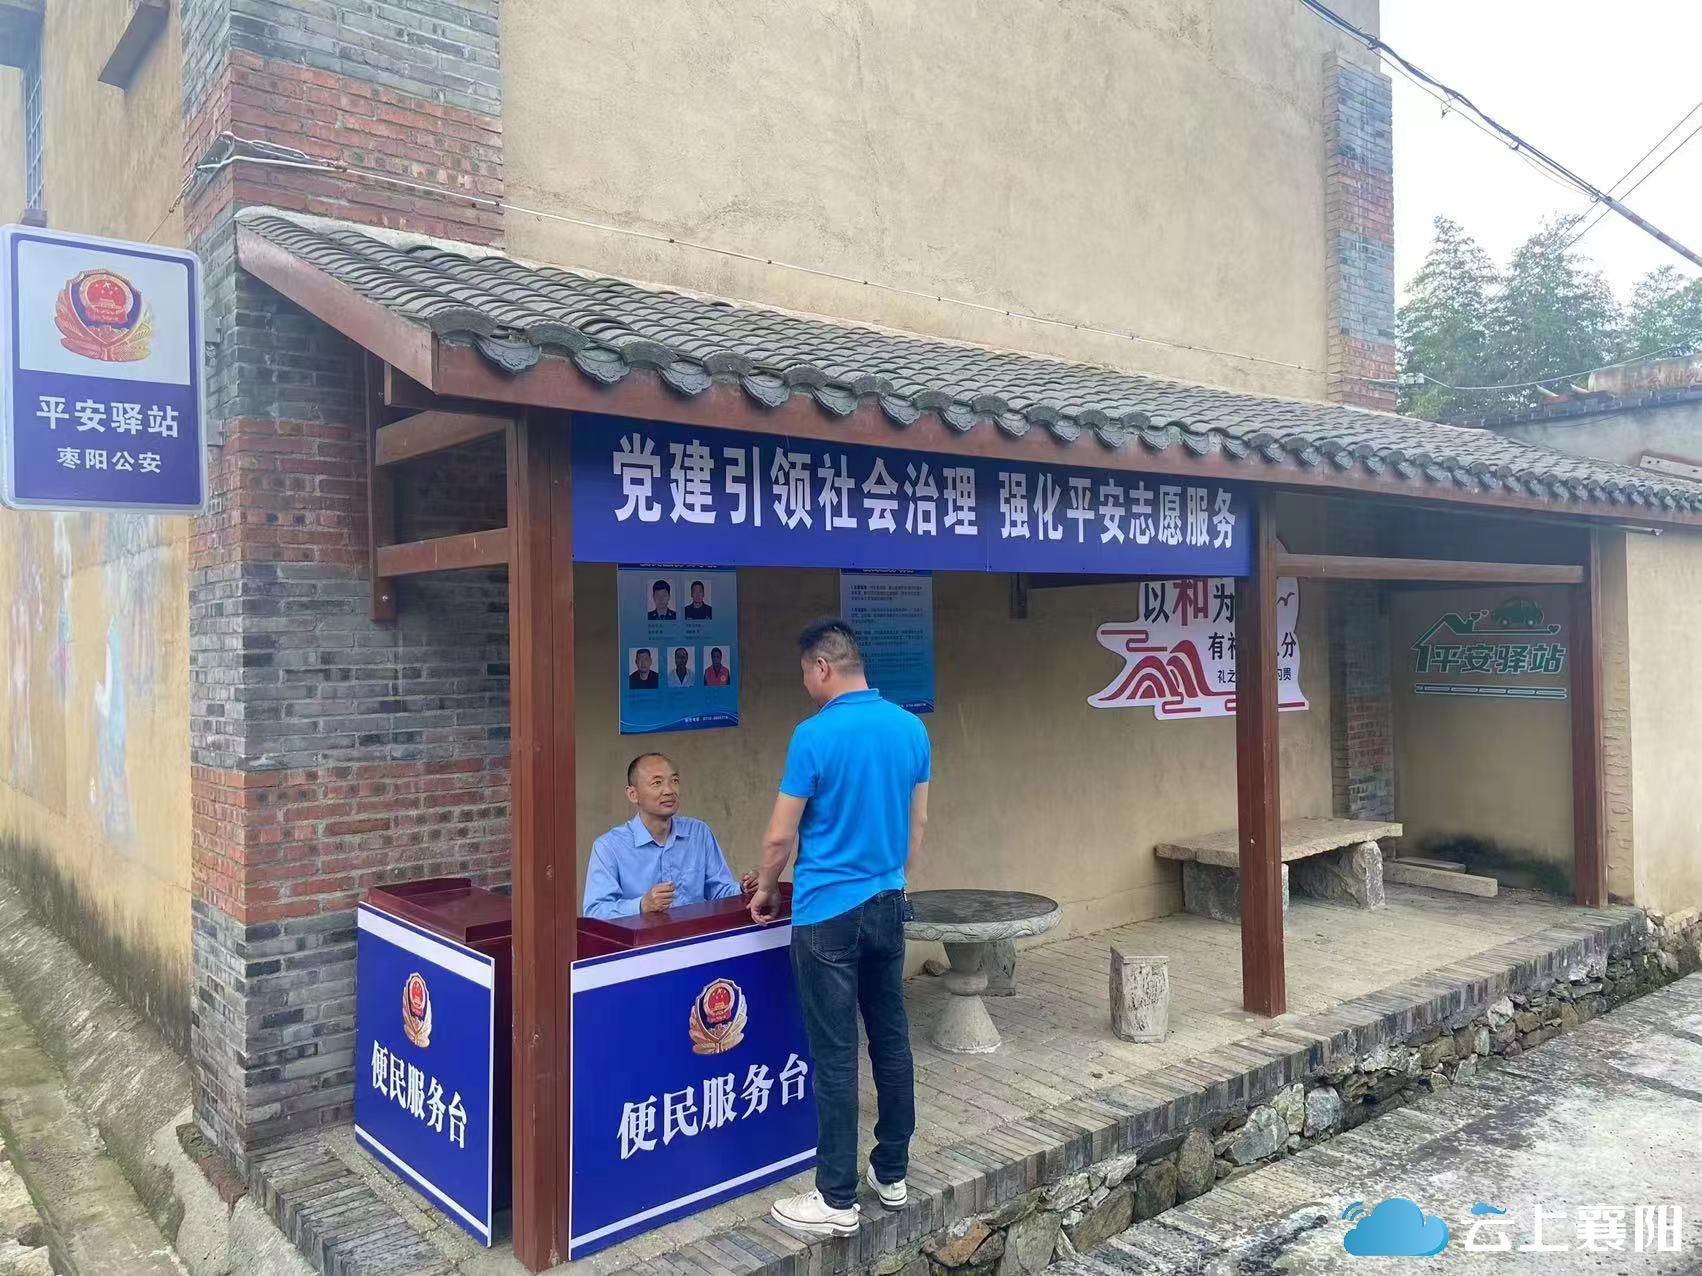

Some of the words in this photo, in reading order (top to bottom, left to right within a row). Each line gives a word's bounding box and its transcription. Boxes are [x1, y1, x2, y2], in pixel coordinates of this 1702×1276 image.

[36, 395, 179, 438] 平安驿站
[56, 447, 162, 473] 枣阳公安
[612, 433, 979, 537] 党建引领社会治理
[1000, 472, 1237, 549] 强化平安志愿服务
[1431, 643, 1566, 674] 平安驿站
[371, 1040, 468, 1149] 便民服务台
[617, 1053, 809, 1160] 便民服务台
